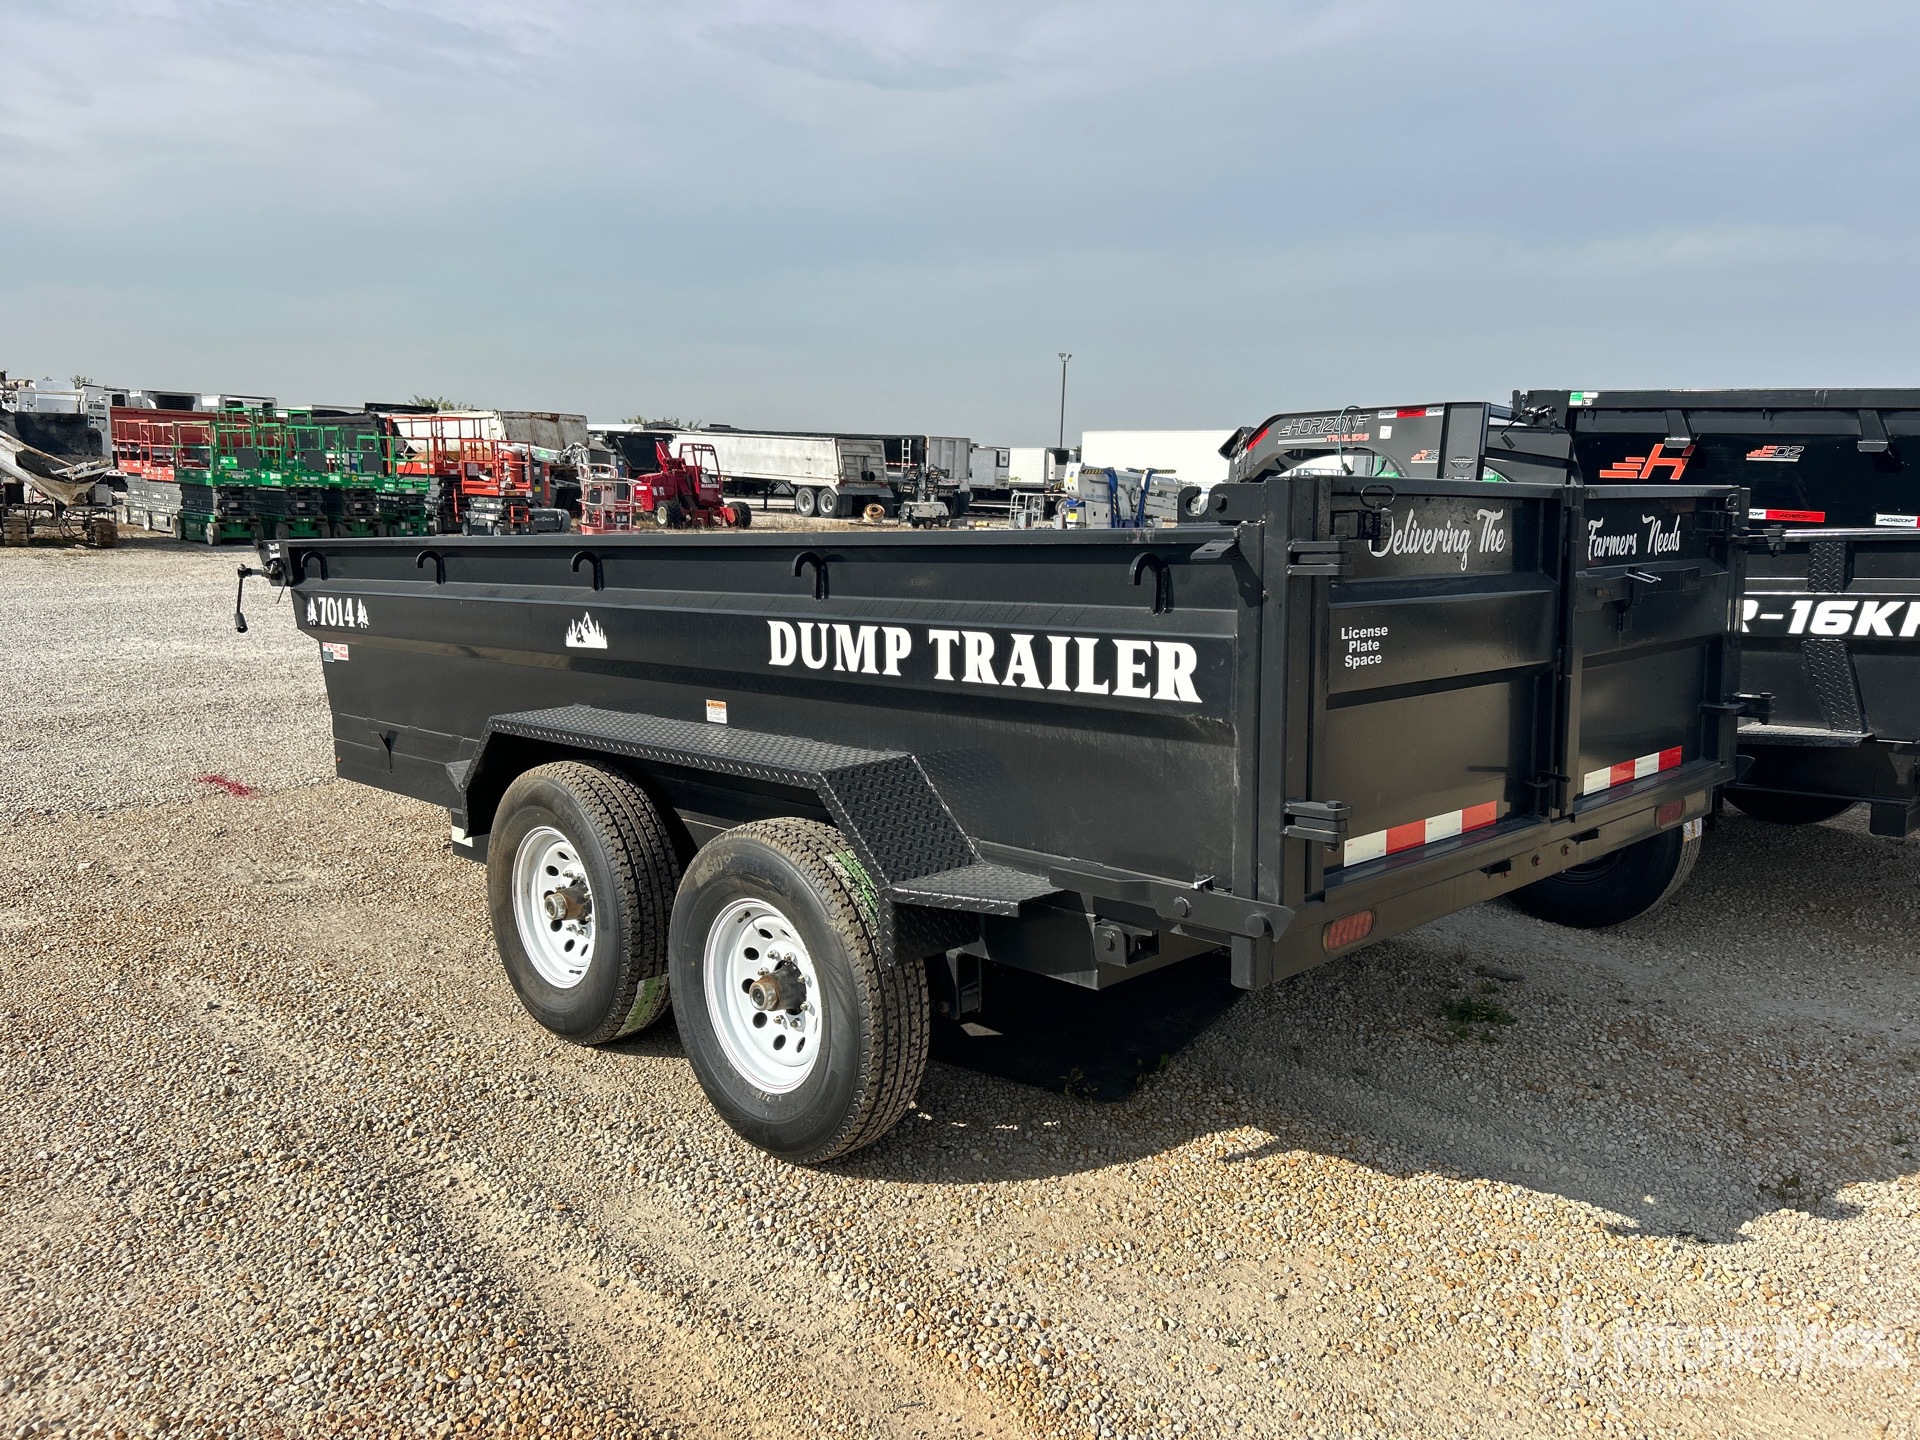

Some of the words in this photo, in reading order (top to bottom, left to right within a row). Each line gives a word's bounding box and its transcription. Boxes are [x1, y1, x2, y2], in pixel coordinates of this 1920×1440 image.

[1279, 415, 1370, 436] HORIZON
[1327, 433, 1370, 442] TRAILERS
[1368, 507, 1472, 572] Delivering
[1476, 508, 1506, 553] The
[1587, 517, 1638, 561] Farmers
[1641, 514, 1680, 556] Needs
[317, 596, 355, 628] 7014
[1341, 626, 1389, 640] License
[1348, 639, 1380, 653] Plate
[766, 620, 912, 677] DUMP
[928, 628, 1203, 704] TRAILER
[1344, 654, 1383, 670] Space
